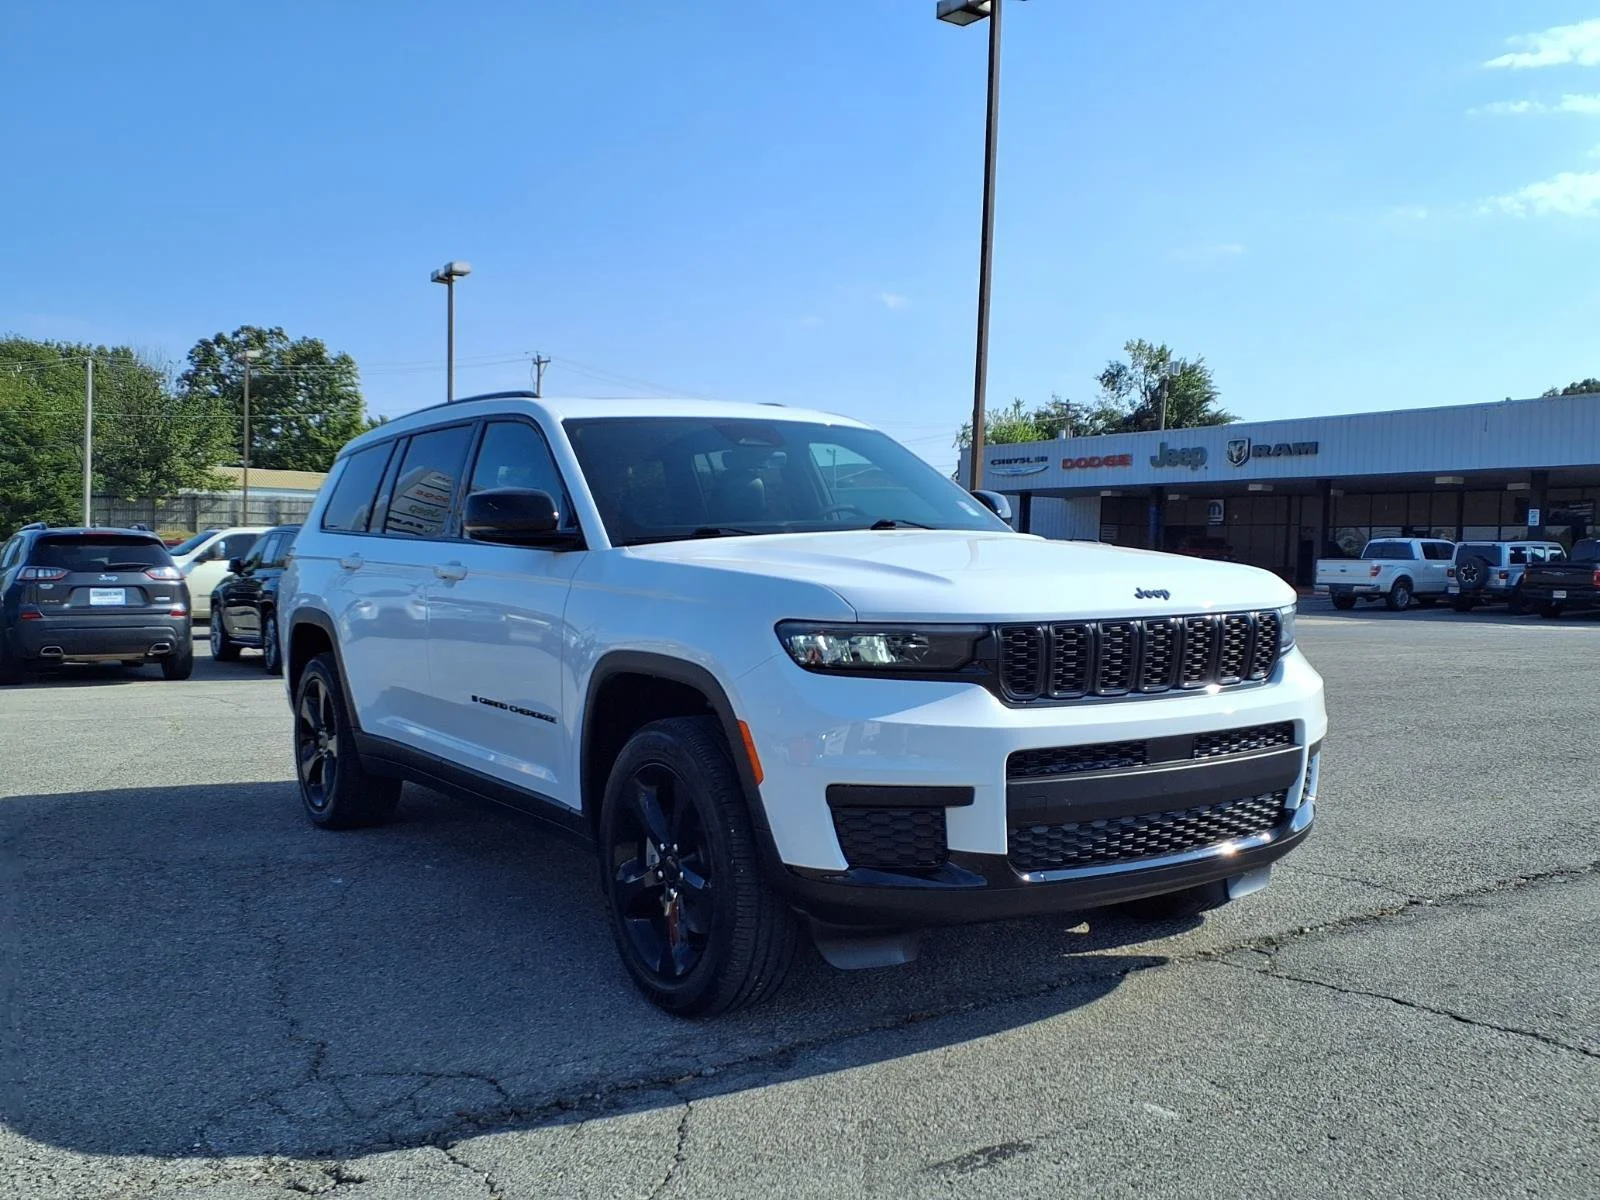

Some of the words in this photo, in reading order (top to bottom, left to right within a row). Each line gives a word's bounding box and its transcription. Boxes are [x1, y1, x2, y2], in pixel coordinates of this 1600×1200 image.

[1150, 442, 1208, 471] Jeep
[1252, 441, 1318, 457] RAM
[1062, 453, 1133, 469] DODGE
[1134, 587, 1170, 600] Jeep
